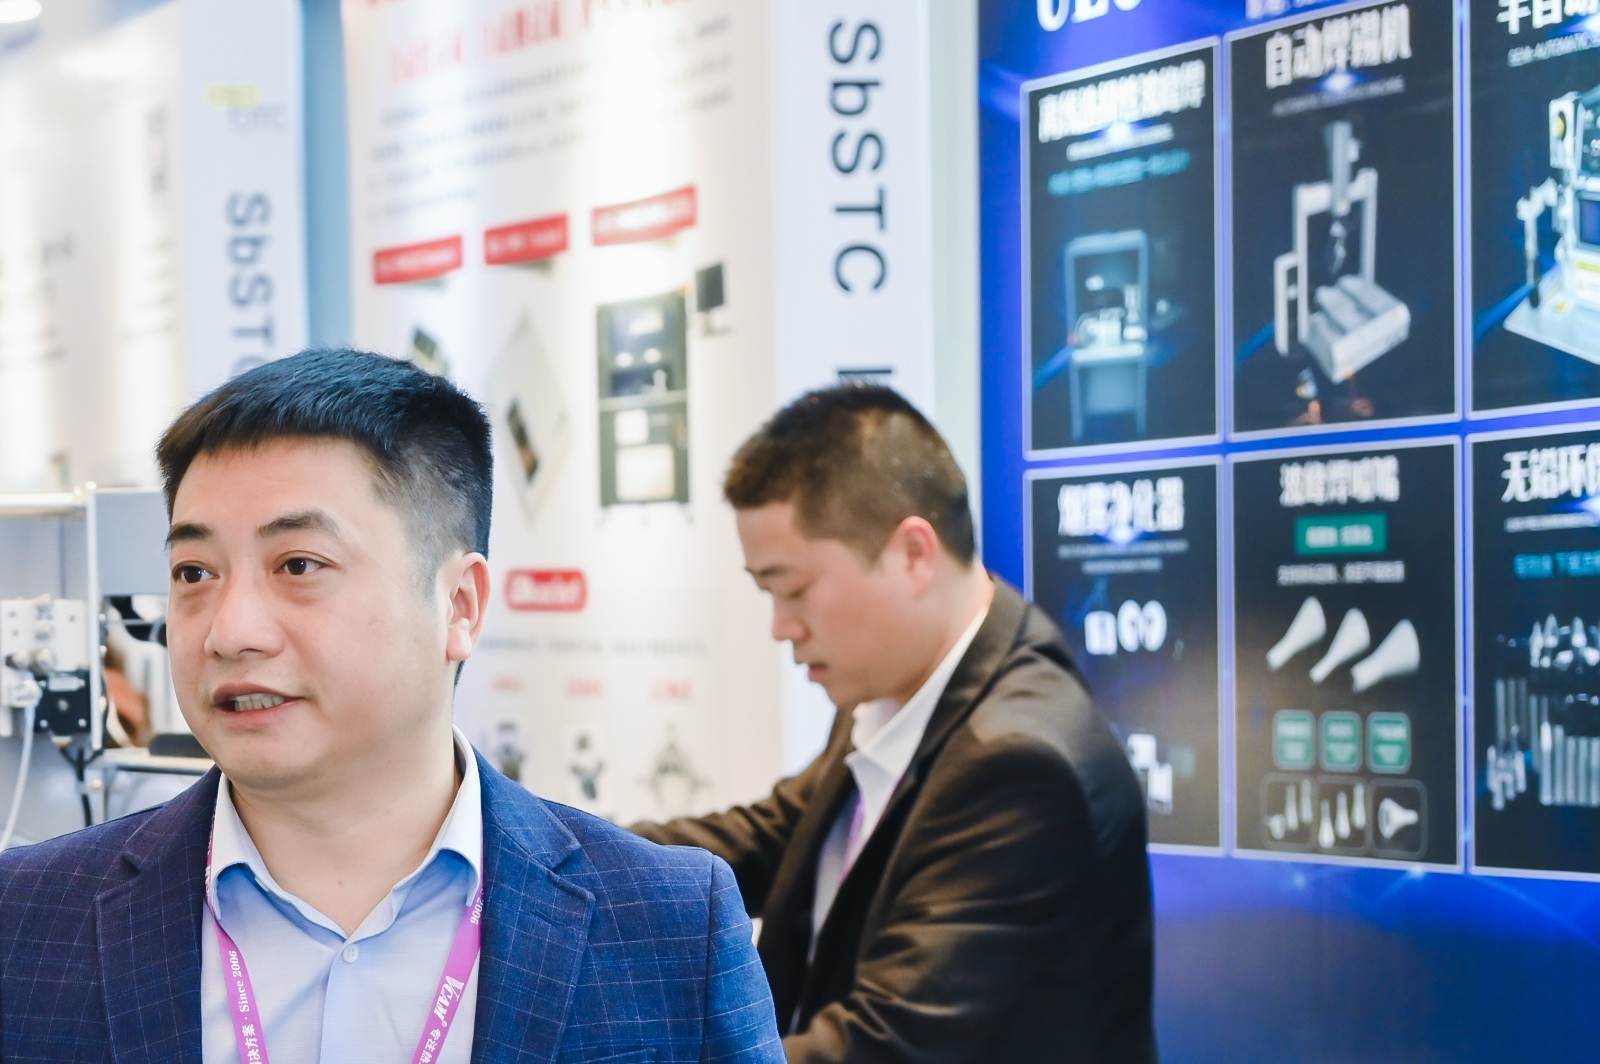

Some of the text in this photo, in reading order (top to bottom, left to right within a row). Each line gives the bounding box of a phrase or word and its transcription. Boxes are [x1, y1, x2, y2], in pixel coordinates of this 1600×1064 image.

[1265, 4, 1412, 88] 自动焊锡机
[827, 19, 889, 293] SbSTC
[230, 950, 243, 978] 2006
[238, 980, 250, 1013] Since
